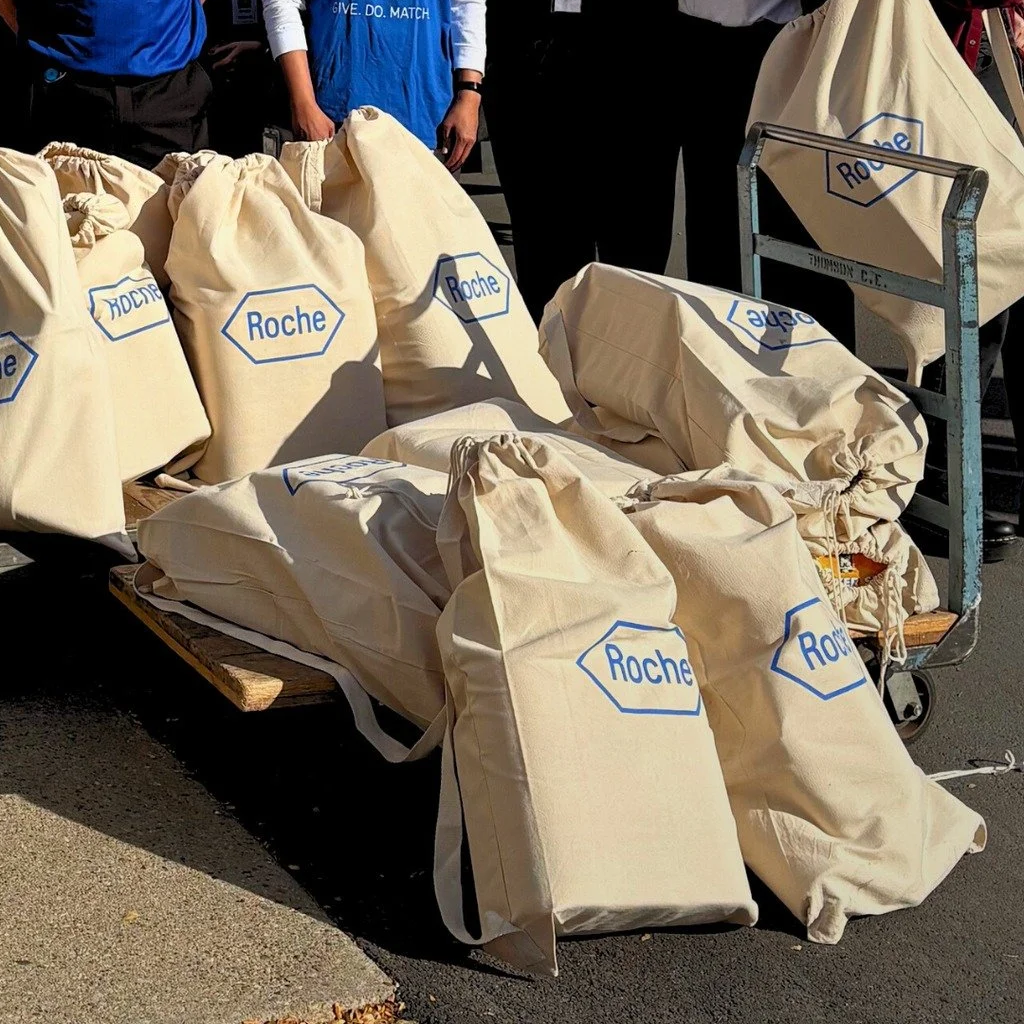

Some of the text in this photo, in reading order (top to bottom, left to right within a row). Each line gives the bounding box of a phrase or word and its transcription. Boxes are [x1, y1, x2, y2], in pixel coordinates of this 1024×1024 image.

[332, 1, 362, 16] GIVE.
[365, 3, 387, 19] DO.
[445, 270, 501, 304] Roche
[247, 305, 327, 341] Roche
[746, 308, 815, 333] oche
[605, 643, 693, 687] Roche
